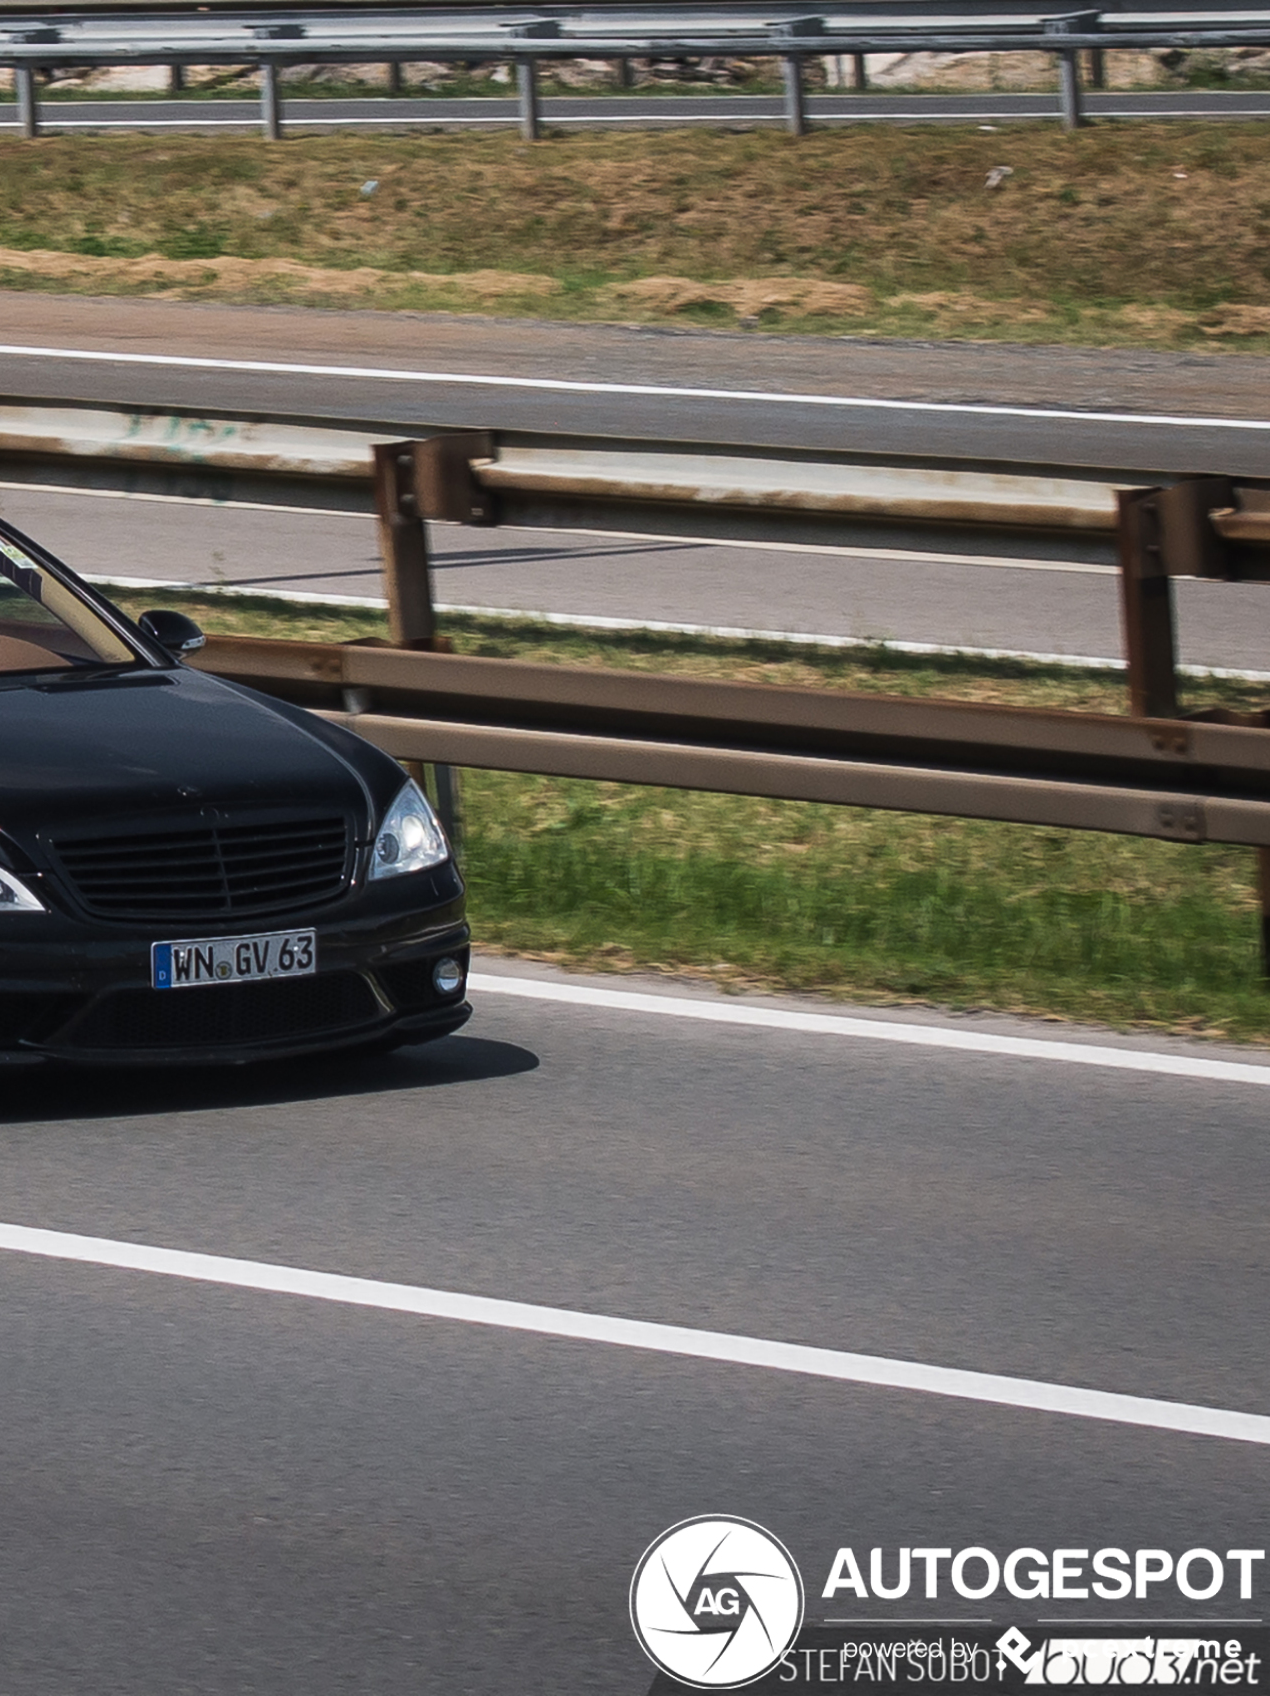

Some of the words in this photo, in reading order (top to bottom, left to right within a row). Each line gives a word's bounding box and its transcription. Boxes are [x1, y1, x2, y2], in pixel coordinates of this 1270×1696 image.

[172, 945, 214, 981] WN
[235, 940, 270, 976] GV
[278, 936, 313, 971] 63
[158, 970, 167, 981] D
